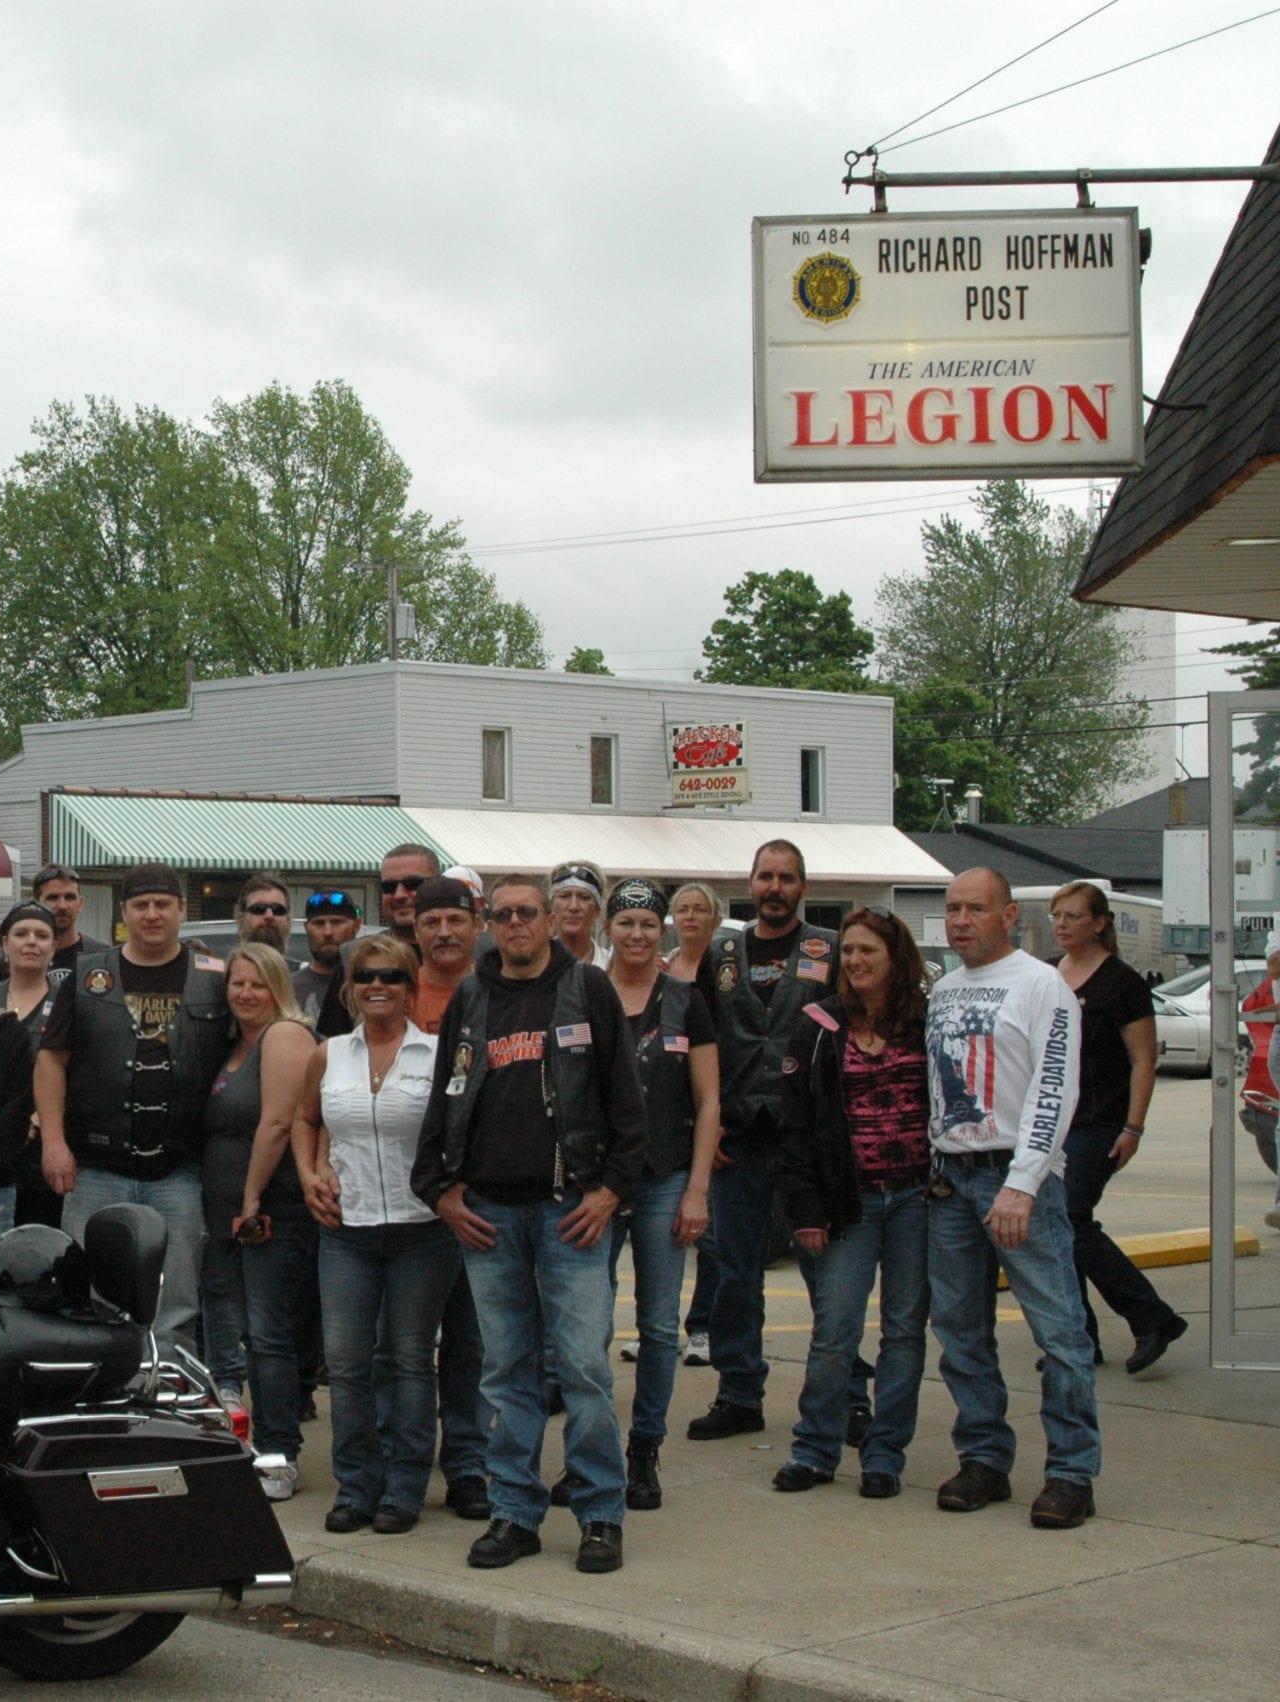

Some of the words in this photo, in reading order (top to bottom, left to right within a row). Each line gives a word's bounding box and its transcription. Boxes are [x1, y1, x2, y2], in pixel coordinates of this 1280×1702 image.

[792, 231, 812, 246] NO.
[817, 228, 850, 244] 484
[878, 236, 981, 273] RICHARD
[1006, 233, 1114, 270] HOFFMAN
[965, 285, 1029, 321] POST
[868, 361, 913, 379] THE
[920, 358, 1036, 379] AMERICAN
[788, 383, 1115, 447] LEGION
[674, 727, 741, 748] CHECKERS
[679, 776, 737, 791] 642-0029
[1242, 917, 1274, 931] PULL
[1027, 1007, 1069, 1154] HARLEY-DAVIDSON
